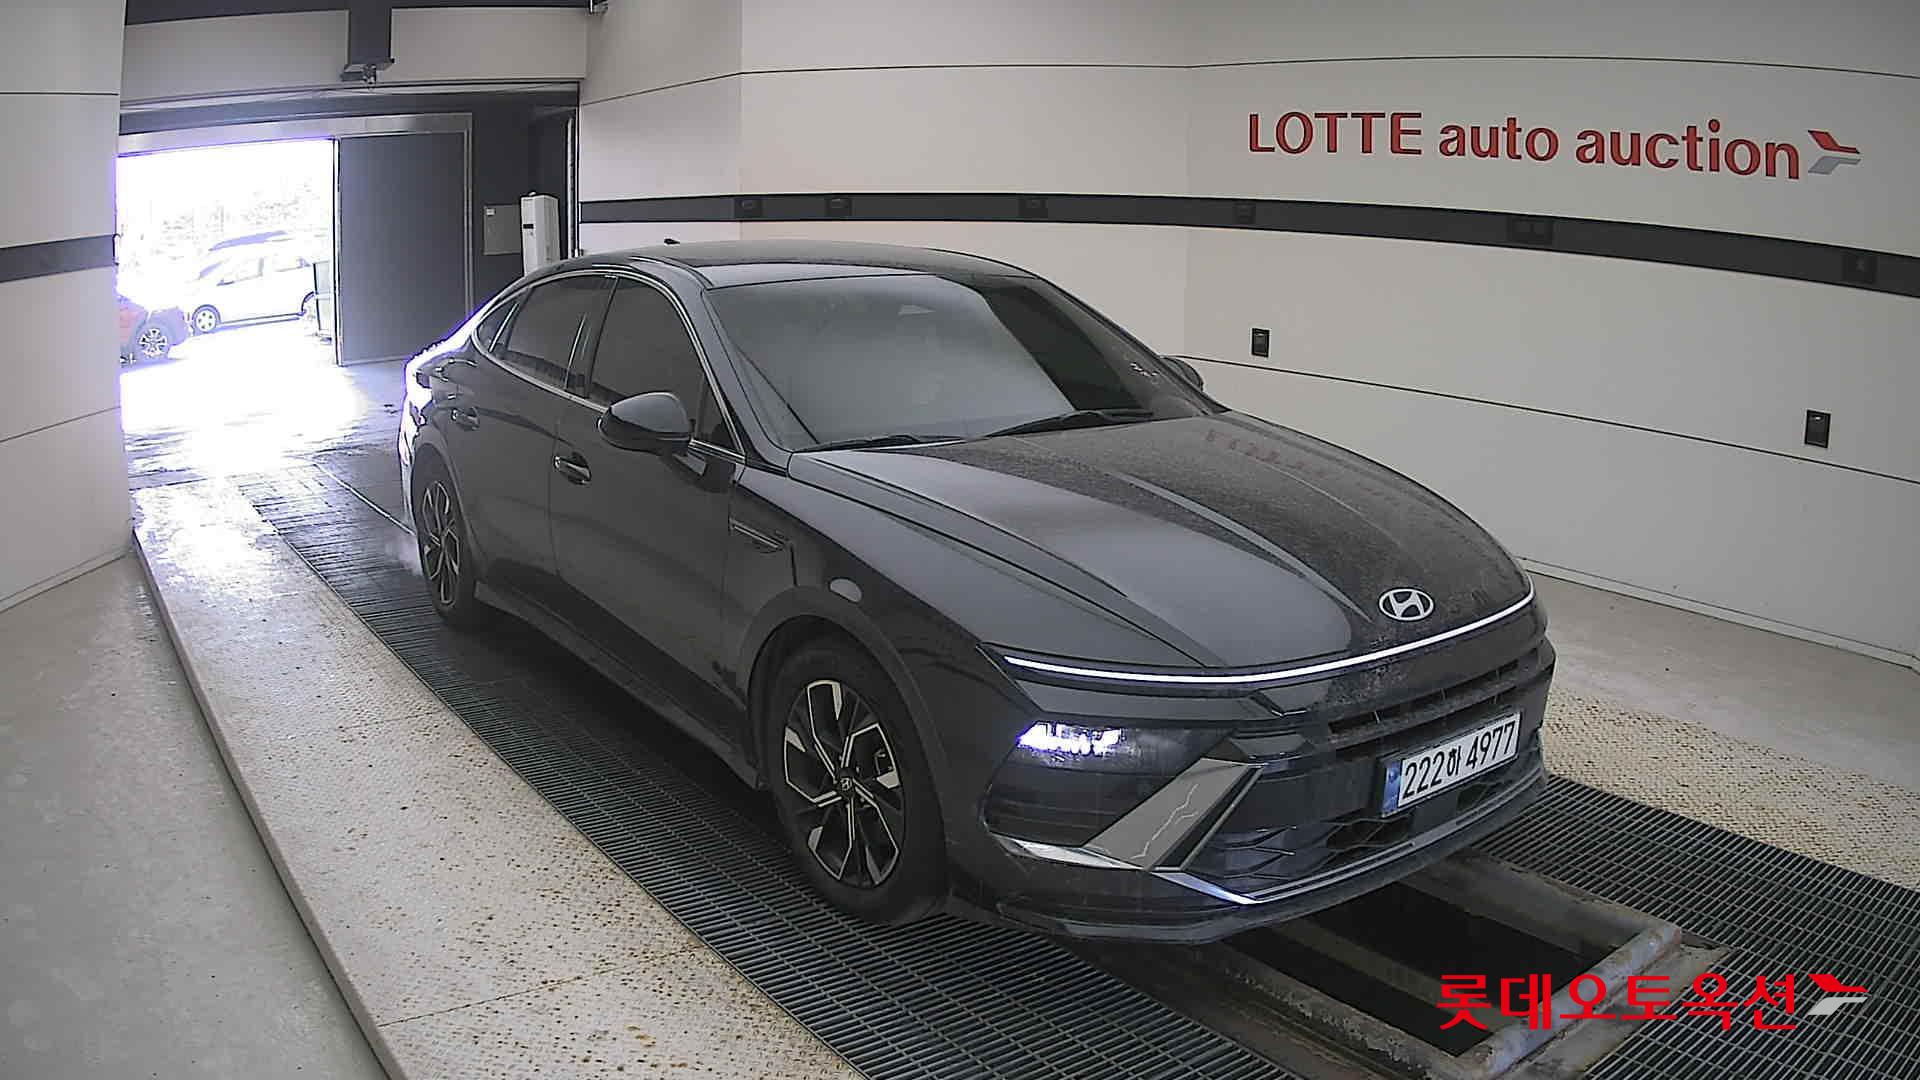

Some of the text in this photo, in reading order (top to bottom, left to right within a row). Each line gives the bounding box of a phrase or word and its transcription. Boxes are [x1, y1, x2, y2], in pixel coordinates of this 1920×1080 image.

[1248, 111, 1801, 181] LOTTE auto auction
[1402, 720, 1517, 800] 222하 4977
